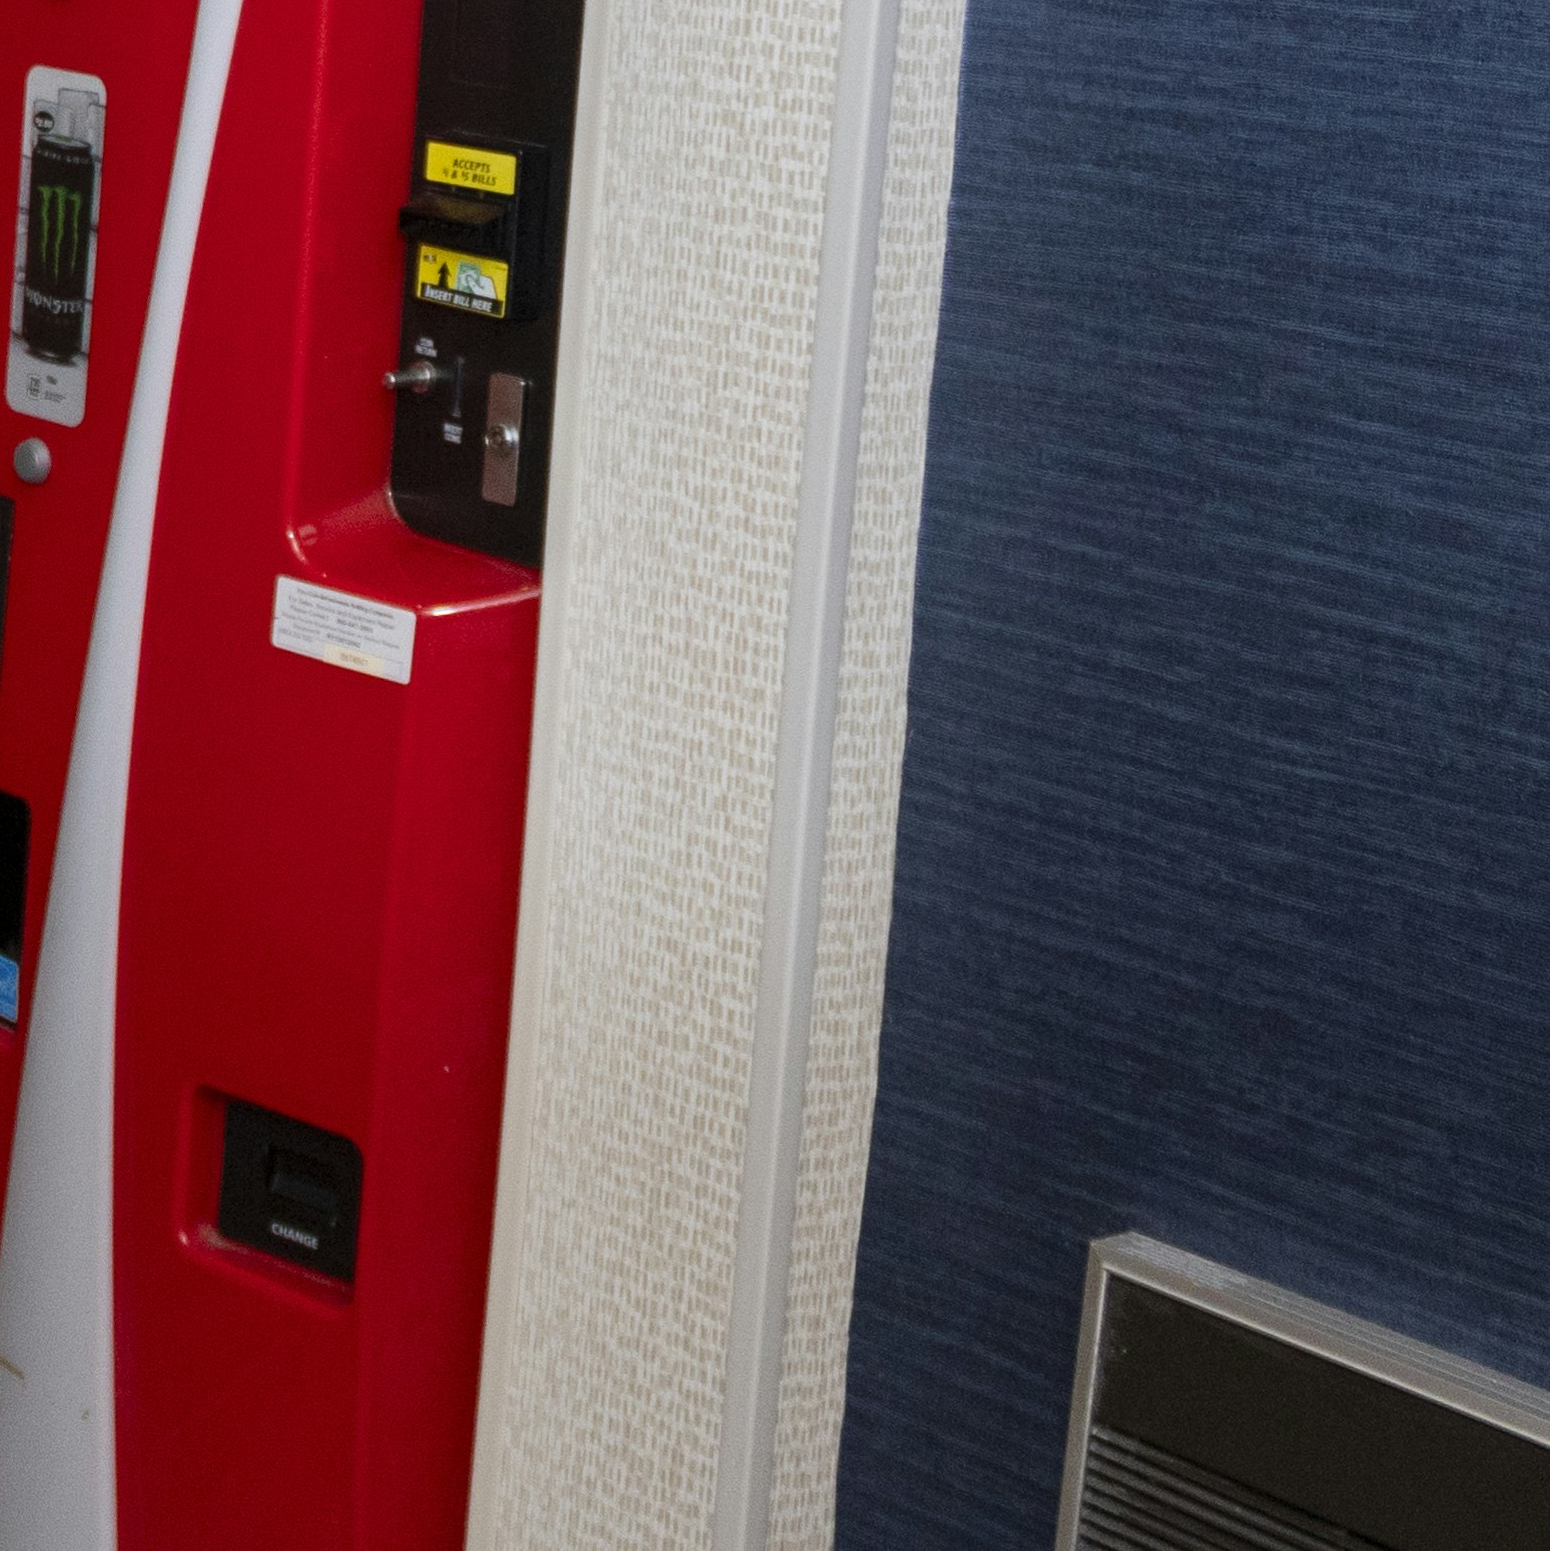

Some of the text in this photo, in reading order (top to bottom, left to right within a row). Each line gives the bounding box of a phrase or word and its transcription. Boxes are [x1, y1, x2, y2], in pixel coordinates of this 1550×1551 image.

[453, 158, 491, 173] ACCEPTS
[472, 173, 497, 186] BILLS
[424, 284, 452, 302] INSERT
[271, 1222, 319, 1250] CHANGE
